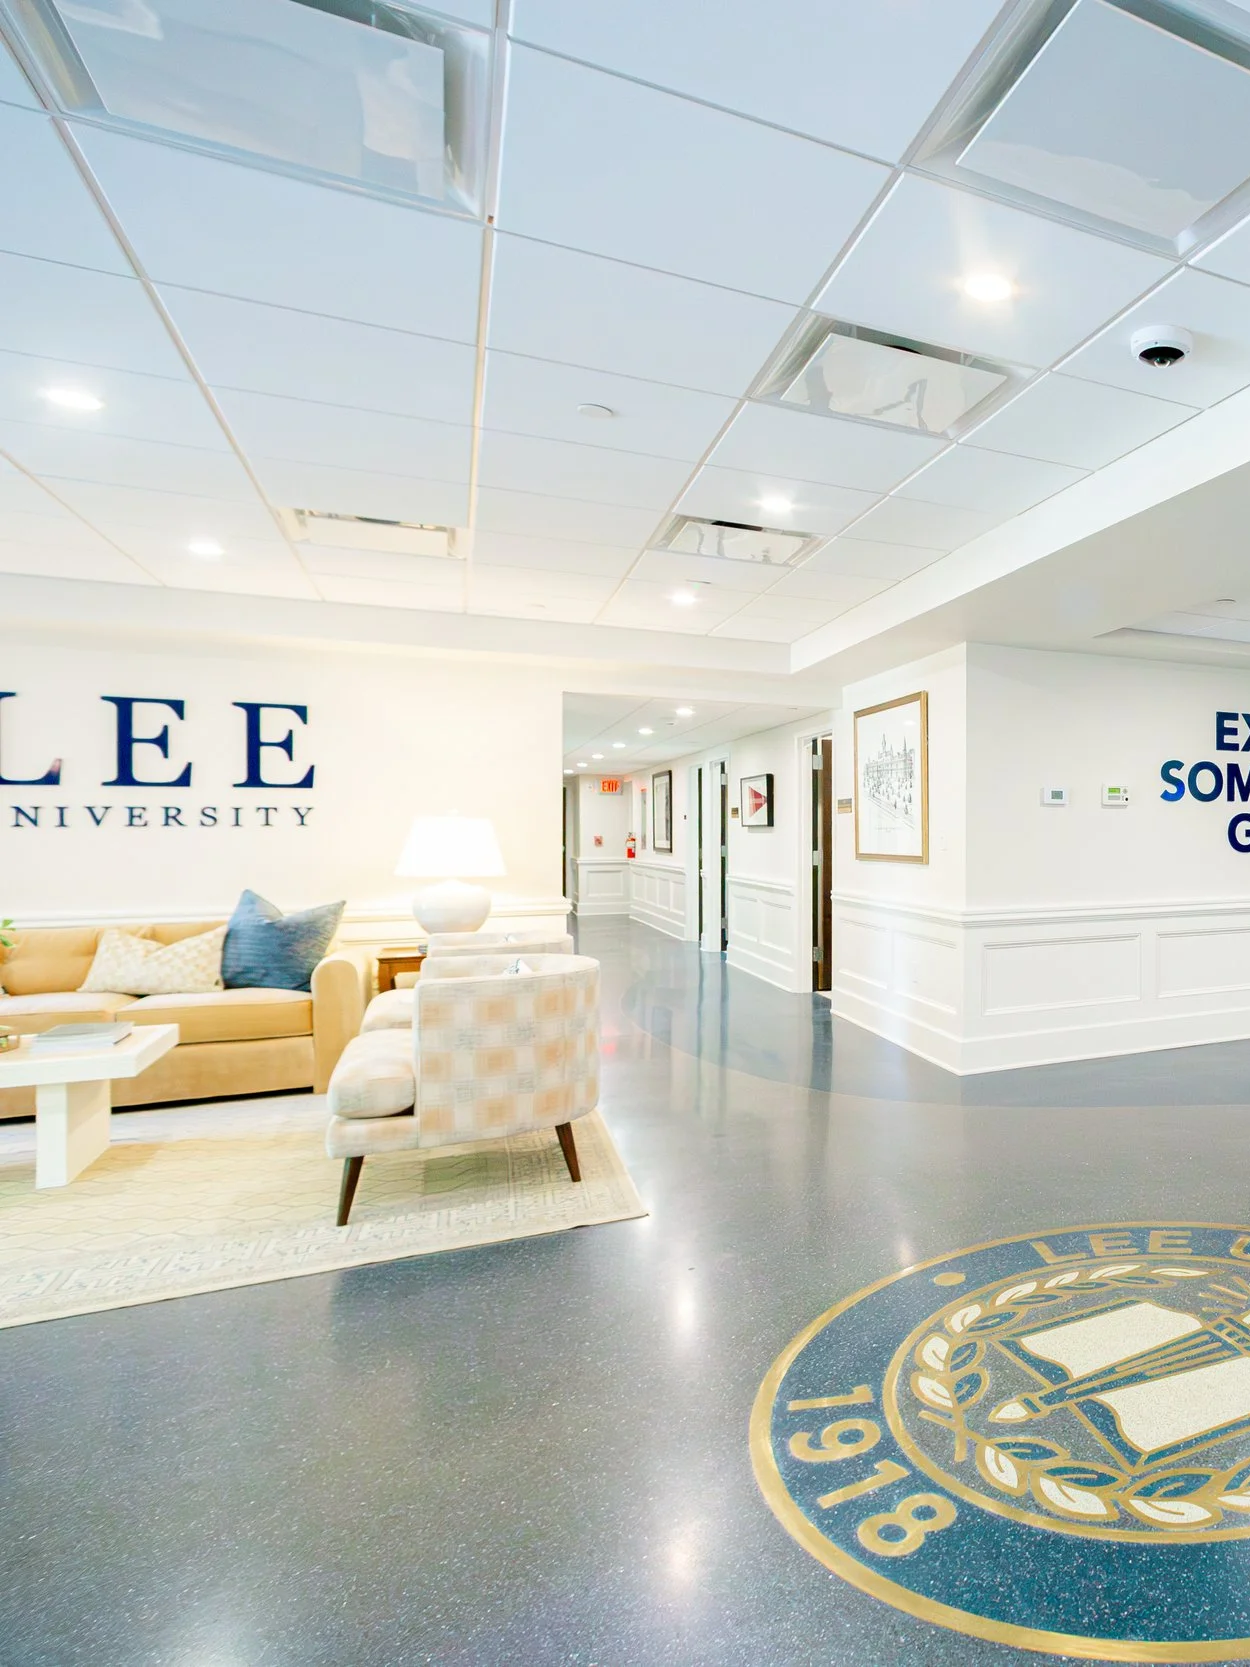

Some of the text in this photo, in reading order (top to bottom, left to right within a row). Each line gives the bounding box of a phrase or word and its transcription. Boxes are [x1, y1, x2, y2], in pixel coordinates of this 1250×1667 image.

[601, 780, 620, 793] EXIT
[10, 805, 315, 828] NIVERSITY
[1030, 1228, 1196, 1266] LEE
[785, 1383, 959, 1559] 1918
